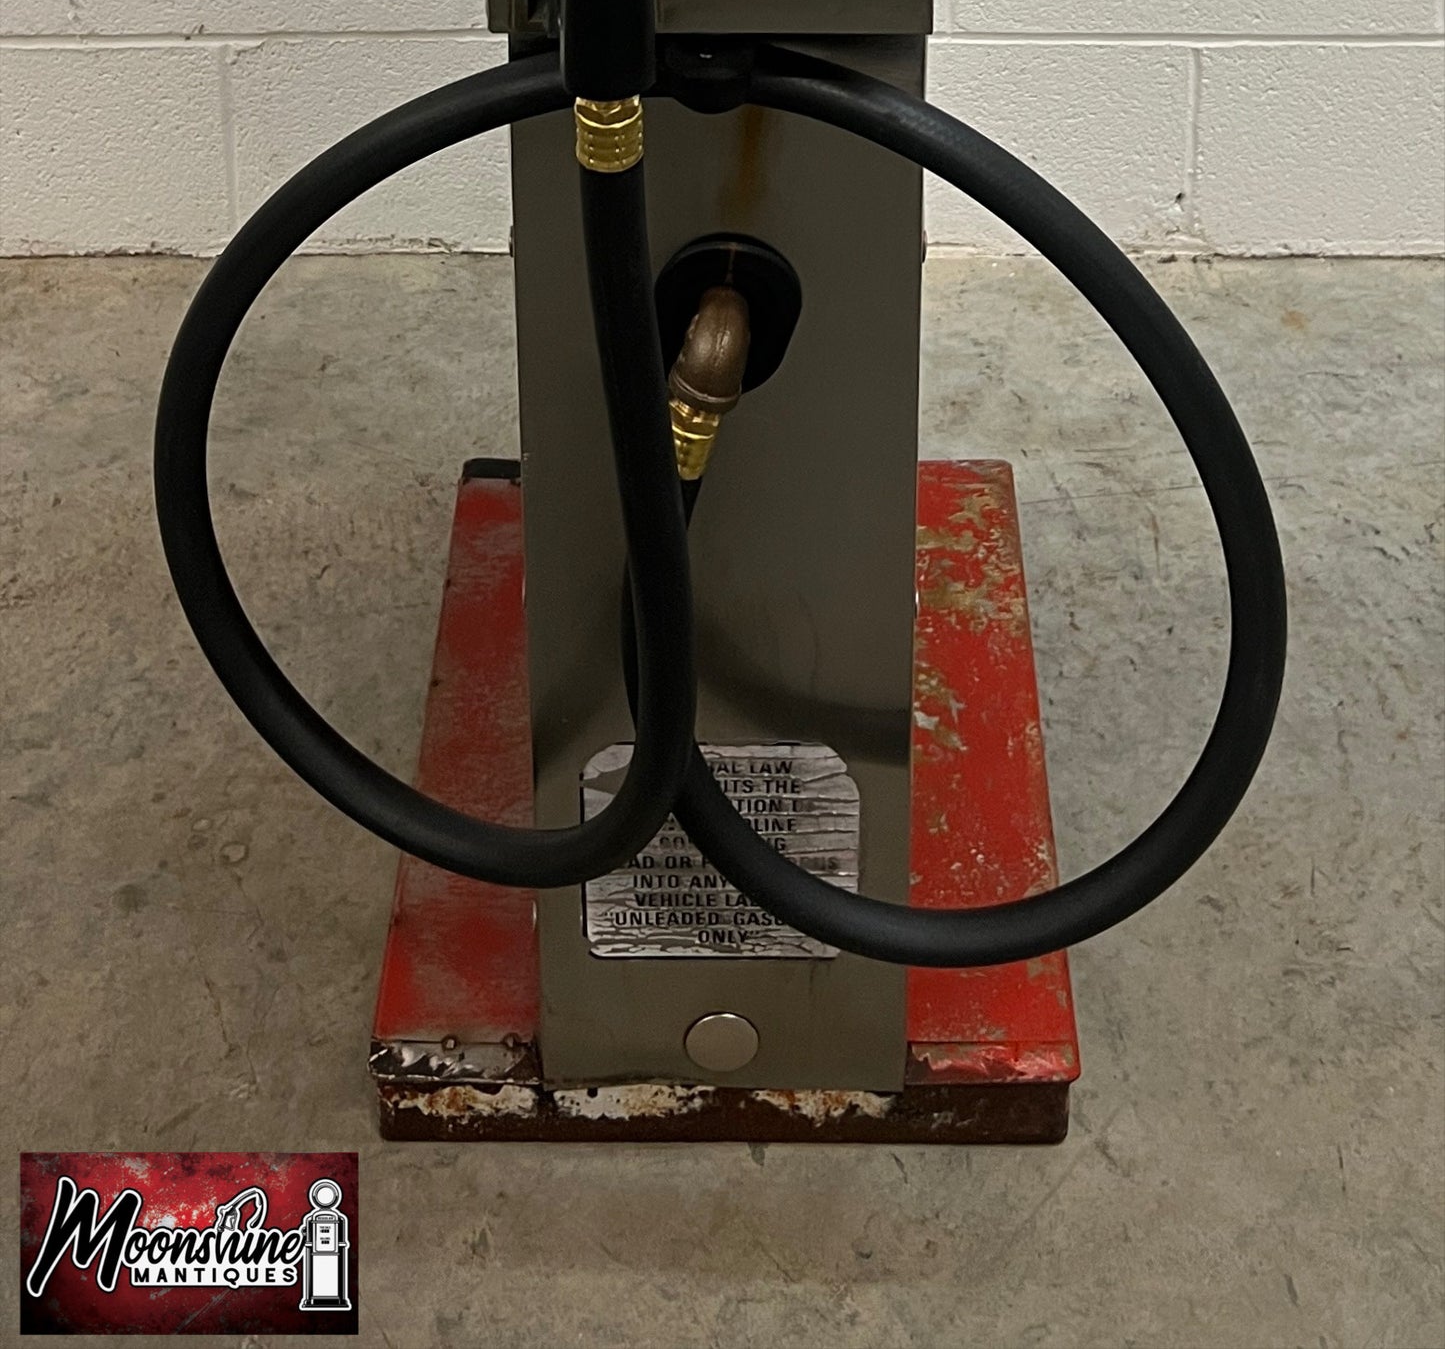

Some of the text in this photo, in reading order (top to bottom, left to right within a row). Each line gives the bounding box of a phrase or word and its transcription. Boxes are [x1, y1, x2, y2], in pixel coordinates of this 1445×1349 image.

[750, 760, 793, 774] LAW
[764, 780, 800, 794] THE
[665, 856, 692, 869] OR
[632, 874, 730, 889] INTO ANY
[634, 893, 718, 907] VEHICLE
